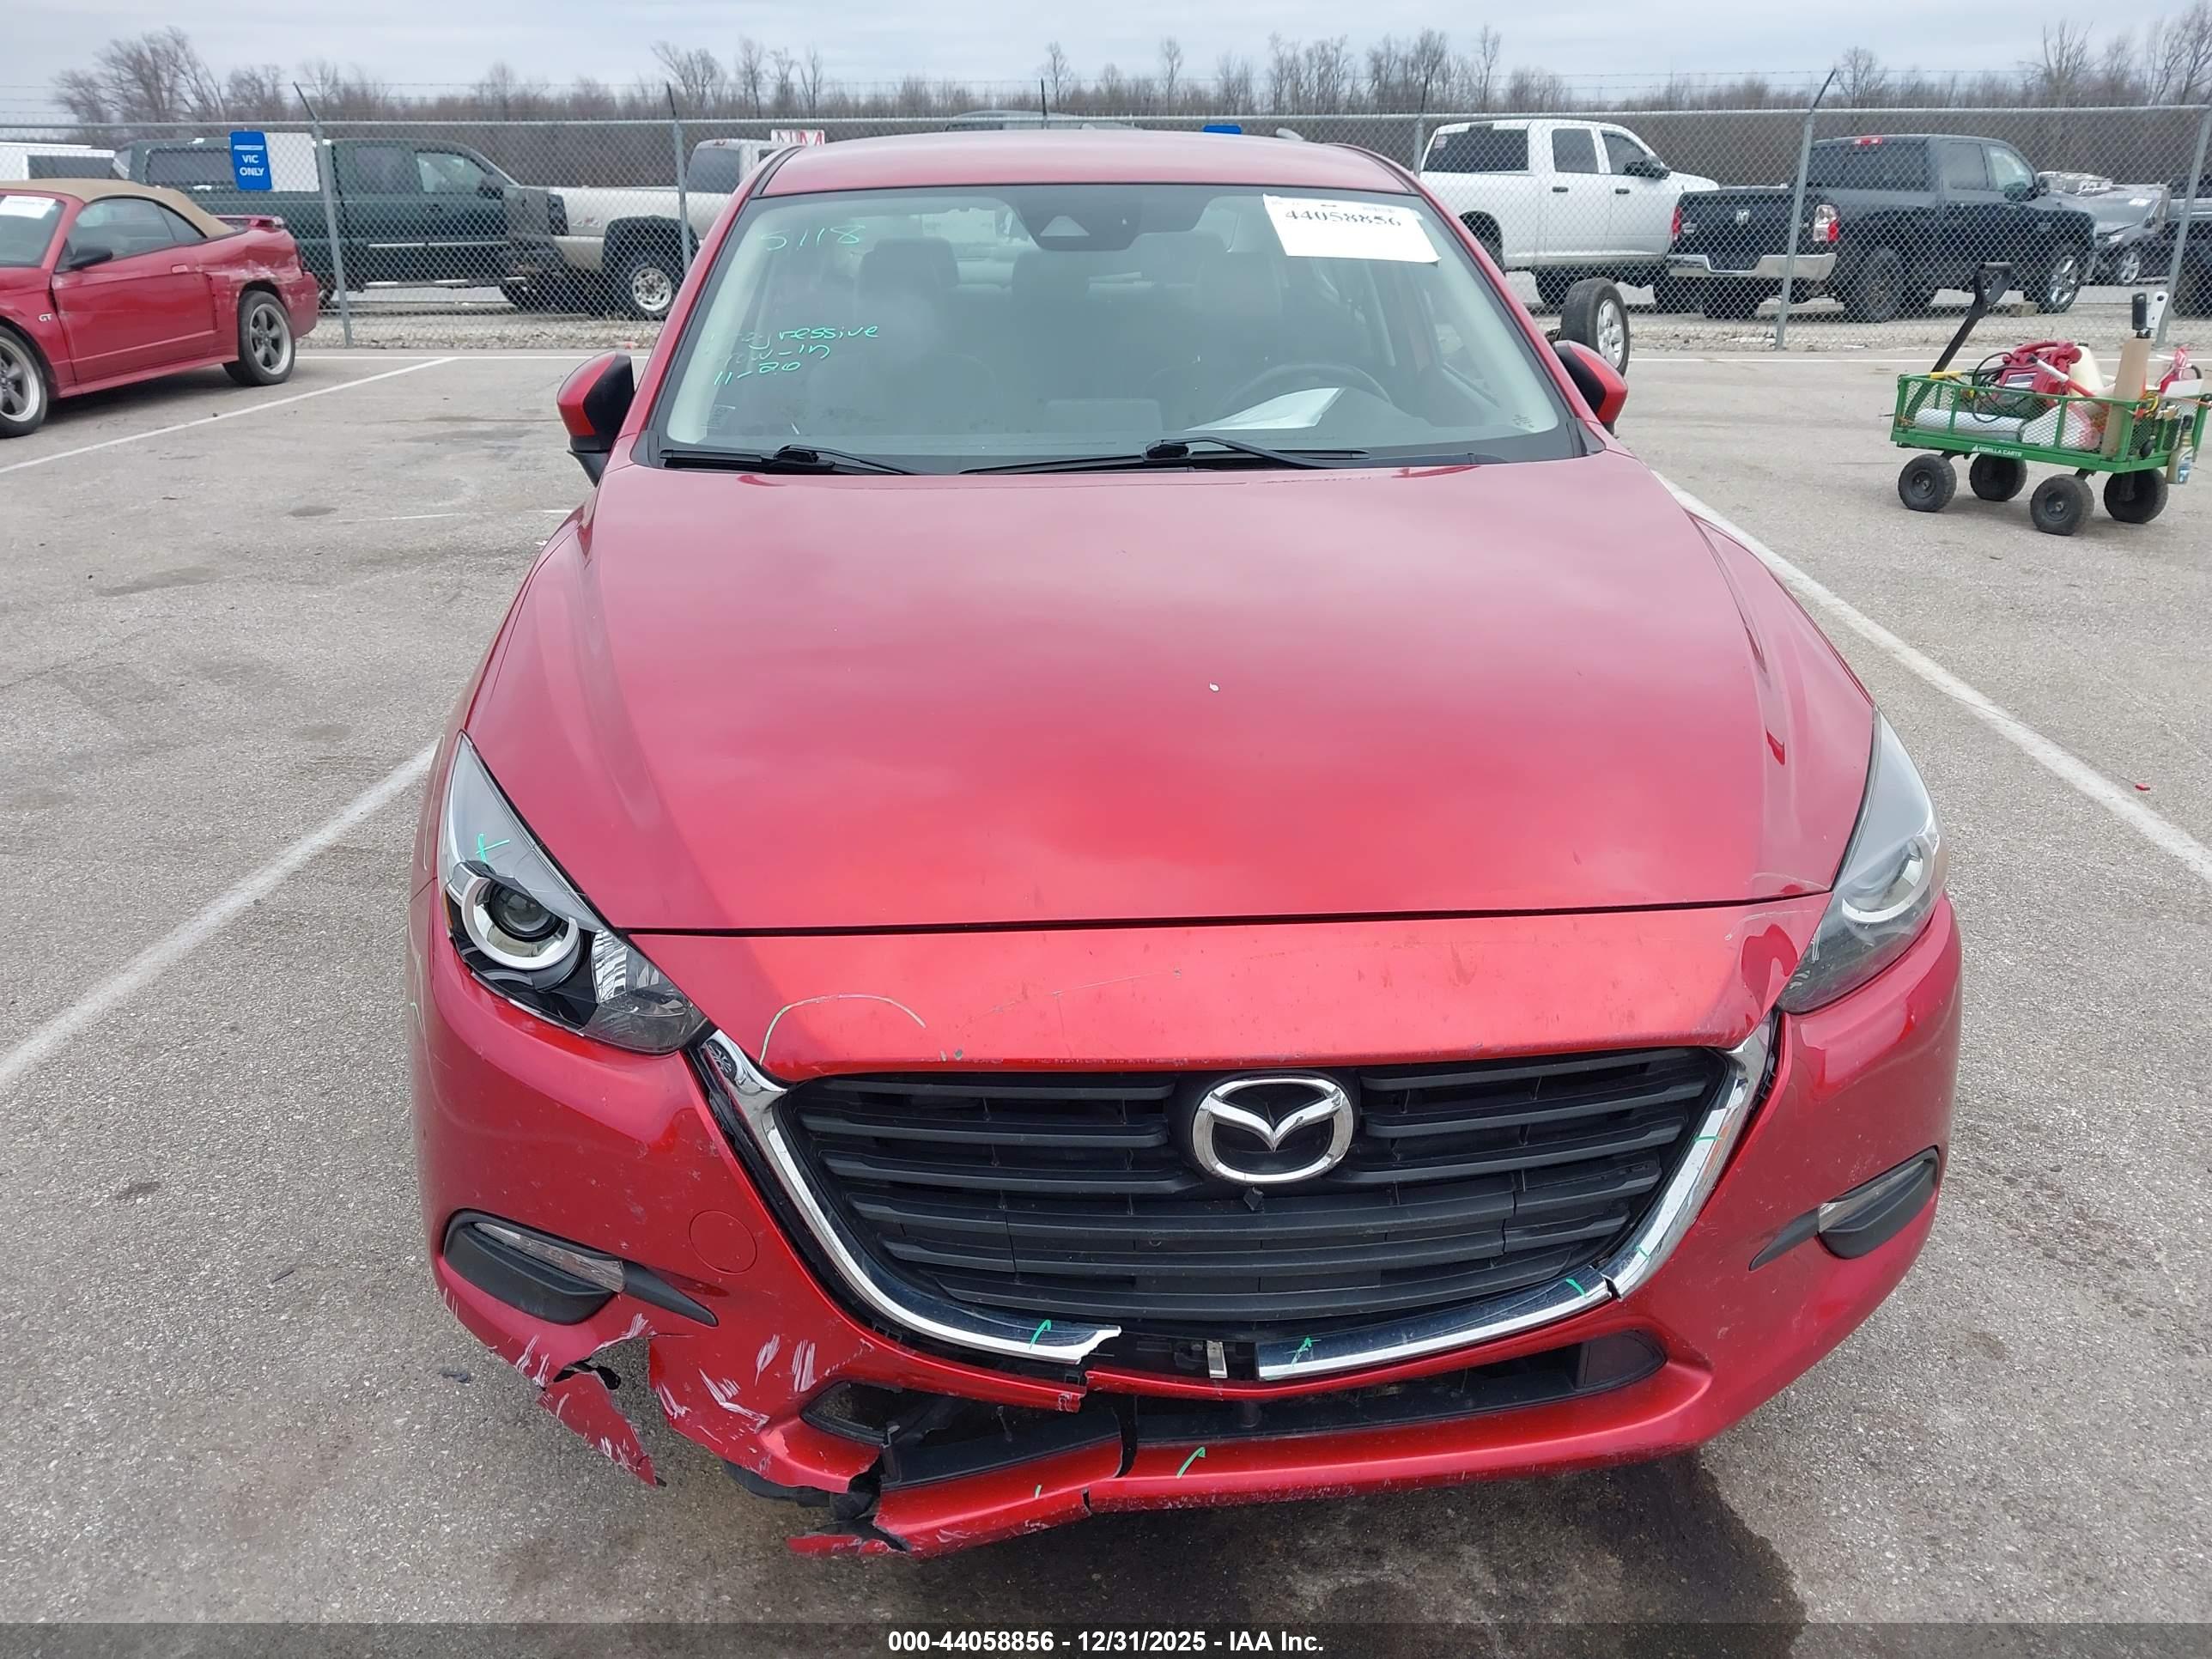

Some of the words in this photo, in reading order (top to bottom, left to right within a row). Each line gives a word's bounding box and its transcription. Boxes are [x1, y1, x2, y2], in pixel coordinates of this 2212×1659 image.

[241, 155, 259, 164] VIC
[239, 167, 264, 177] ONLY
[1285, 210, 1401, 227] 44058856
[38, 313, 52, 322] GT
